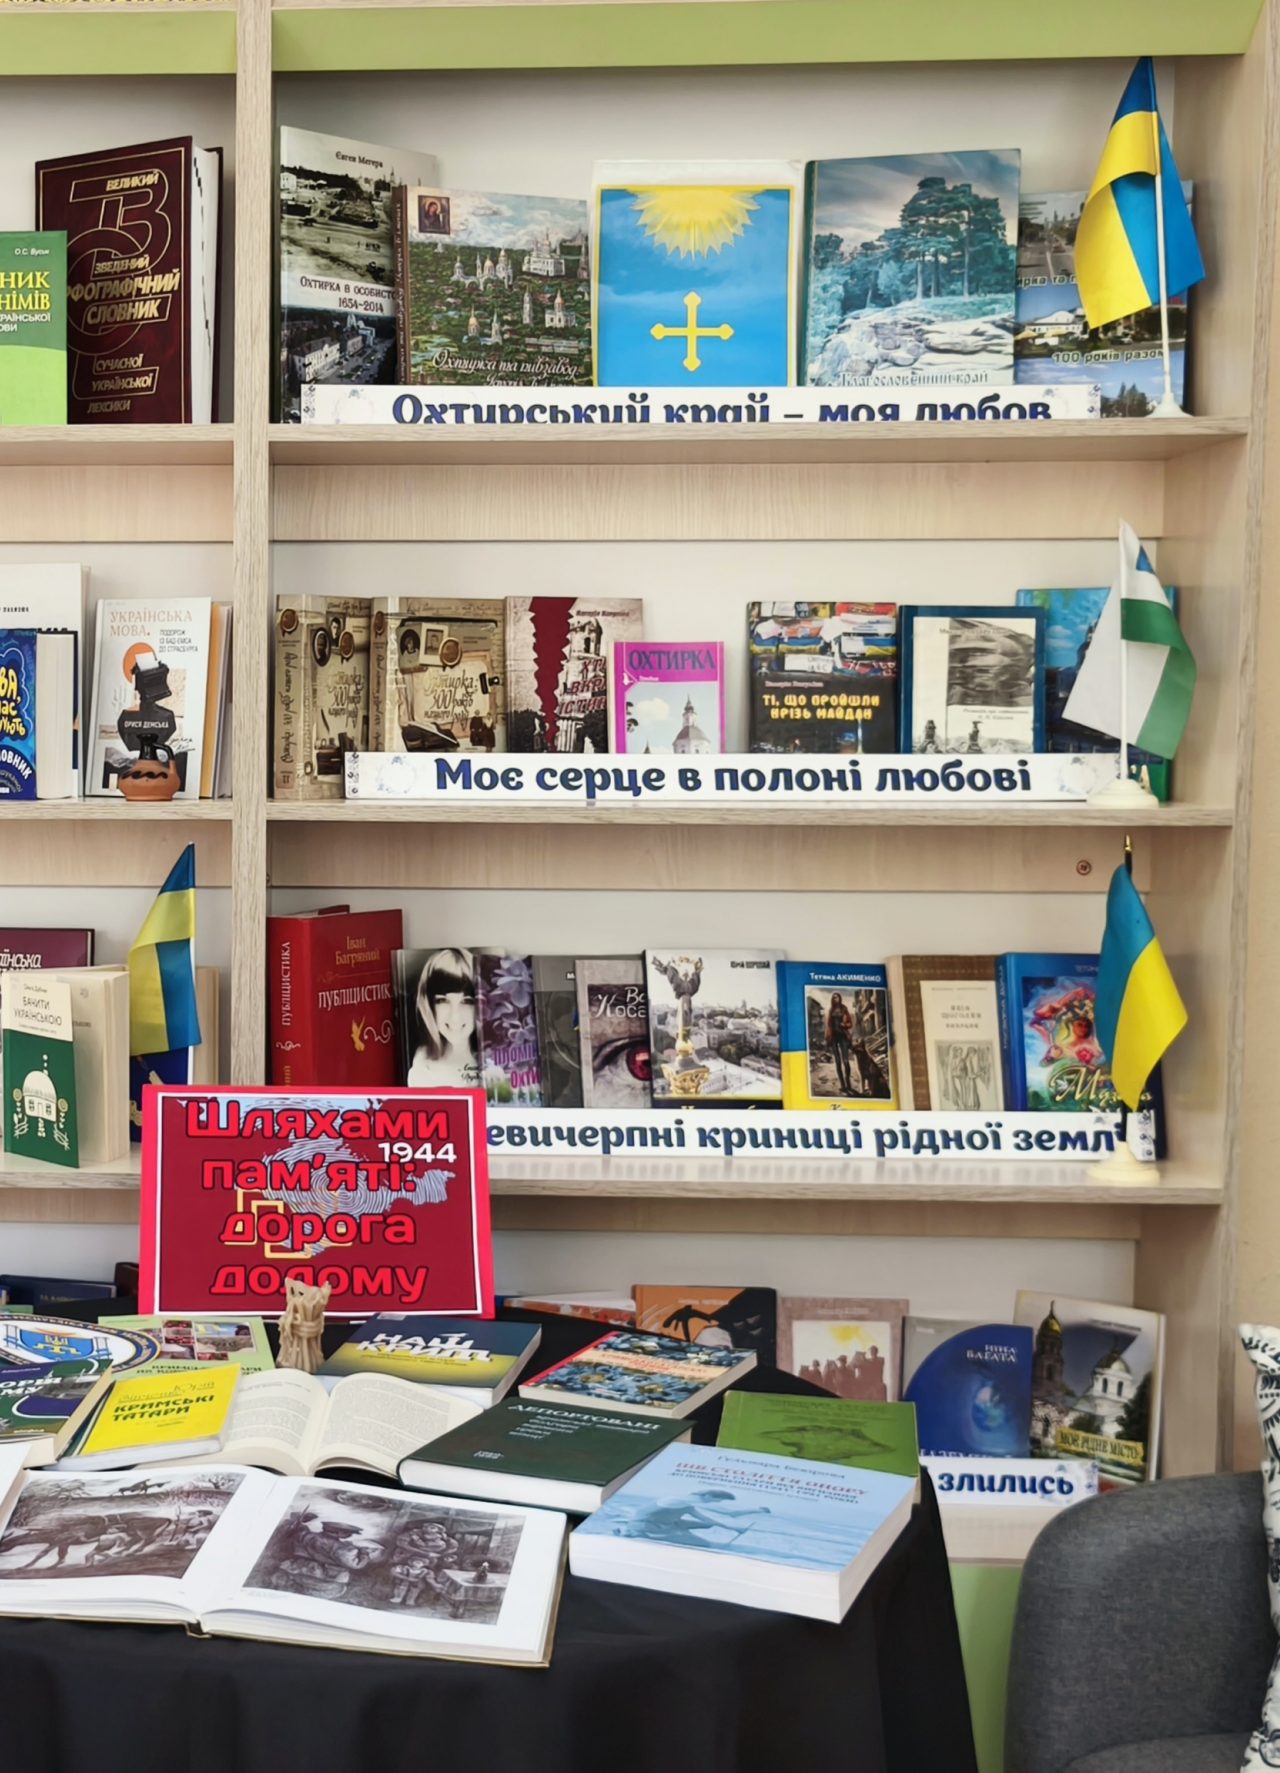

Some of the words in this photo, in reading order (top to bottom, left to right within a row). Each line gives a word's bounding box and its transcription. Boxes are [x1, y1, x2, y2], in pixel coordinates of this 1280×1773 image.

[335, 151, 357, 163] Євген
[106, 171, 160, 192] ВЕЛИКИЙ
[95, 254, 150, 274] ЗВЕДЕНИЙ
[67, 268, 181, 302] ФОГРАФІЧНИЙ
[87, 299, 161, 325] СЛОВНИК
[95, 353, 144, 371] СУЧАСНОЇ
[432, 349, 496, 374] Охтирка
[499, 360, 518, 372] та
[520, 356, 580, 379] пивзавод.
[1053, 352, 1080, 365] 100
[1084, 352, 1119, 366] років
[92, 373, 154, 392] УКРАЇНСЬКОЇ
[955, 371, 988, 385] край
[87, 400, 131, 414] ЛЕКСИКИ
[392, 393, 650, 424] Охтирський
[663, 392, 770, 423] край
[819, 402, 900, 421] моя
[915, 393, 1051, 421] любов
[110, 607, 193, 623] УКРАЇНСЬКА
[110, 625, 150, 637] МОВА.
[628, 649, 716, 672] ОХТИРКА
[762, 694, 780, 707] ТІ,
[784, 695, 807, 707] ЩО
[811, 693, 880, 707] ПРОЙШЛИ
[770, 708, 812, 719] КРІЗЬ
[816, 707, 873, 720] МАЙДАН
[124, 720, 142, 729] ОРИСЯ
[143, 720, 169, 729] ДЕМСЬКА
[434, 758, 523, 790] Моє
[535, 768, 665, 799] серце
[678, 768, 702, 791] в
[715, 759, 862, 791] полоні
[875, 759, 1032, 791] любові
[346, 935, 366, 950] Іван
[281, 942, 291, 1027] ПУБЛІЦИСТИКА
[837, 973, 881, 983] АКИМЕНКО
[318, 983, 392, 1010] ПУБЛІЦИСТИК
[186, 1099, 450, 1140] Шляхами
[487, 1119, 686, 1155] евичерпні
[697, 1119, 862, 1155] криниці
[873, 1120, 1002, 1157] рідної
[378, 1142, 457, 1164] 1944
[219, 1212, 416, 1251] дорога
[112, 1405, 190, 1421] ТАТАРИ
[114, 1394, 215, 1413] КРИМСЬКІ
[508, 1404, 661, 1430] ДЕПОРТОВАНІ
[937, 1473, 1074, 1496] злились
